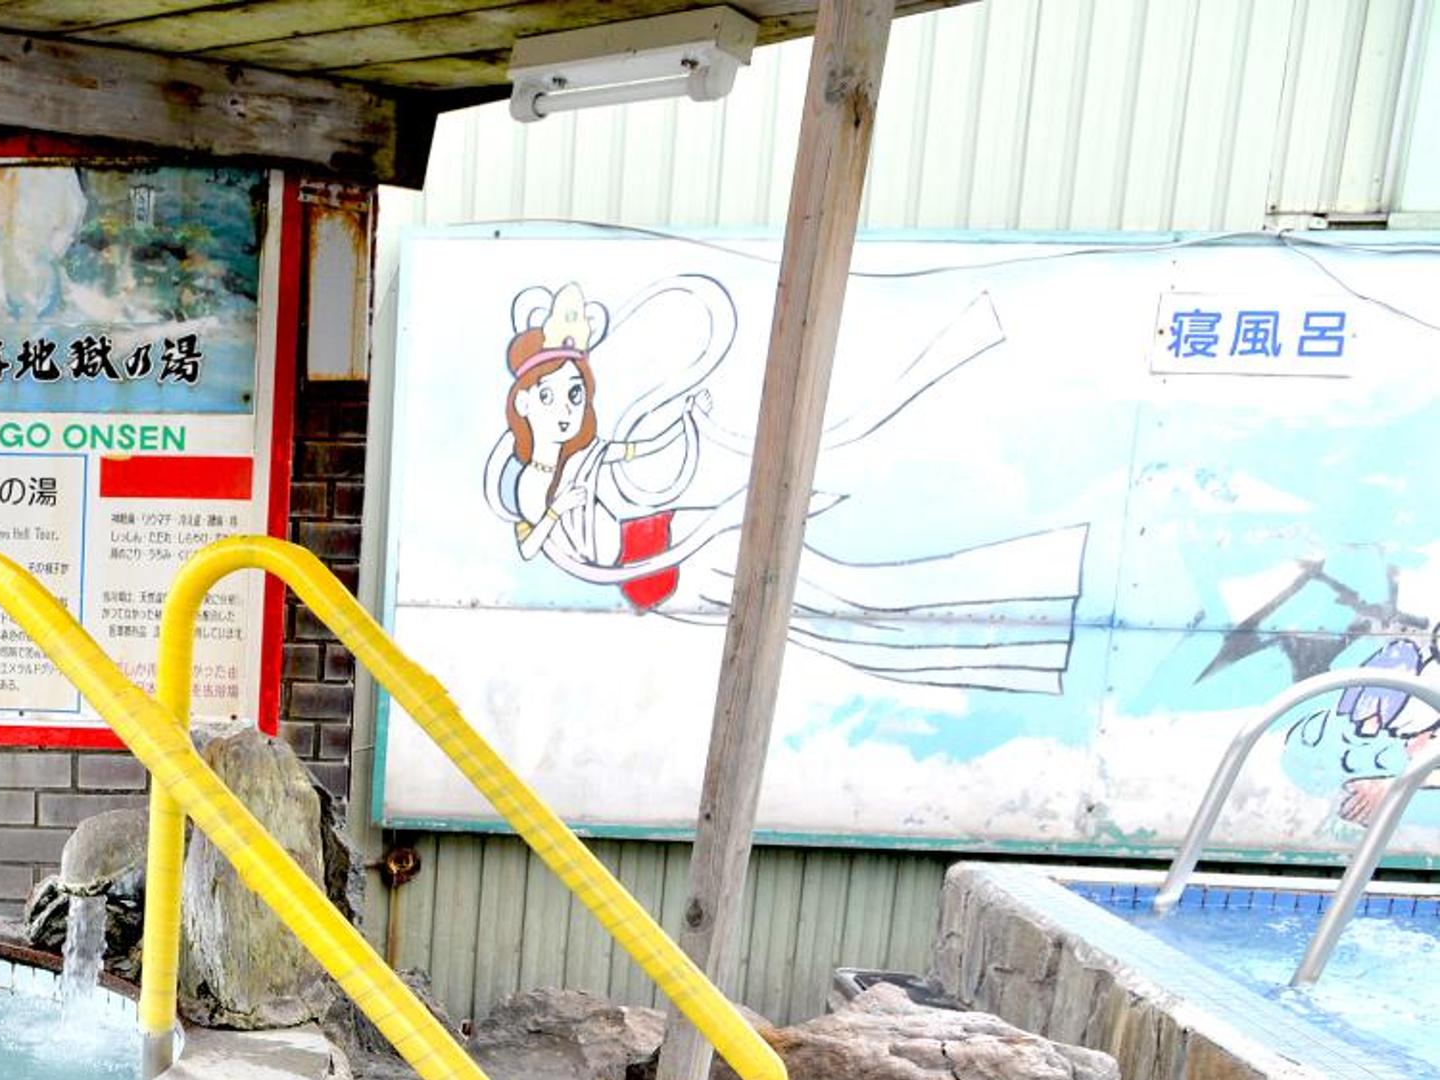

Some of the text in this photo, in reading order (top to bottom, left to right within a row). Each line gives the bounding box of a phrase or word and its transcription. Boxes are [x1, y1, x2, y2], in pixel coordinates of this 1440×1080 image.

[1167, 308, 1347, 358] 寝風呂
[62, 425, 187, 451] ONSEN
